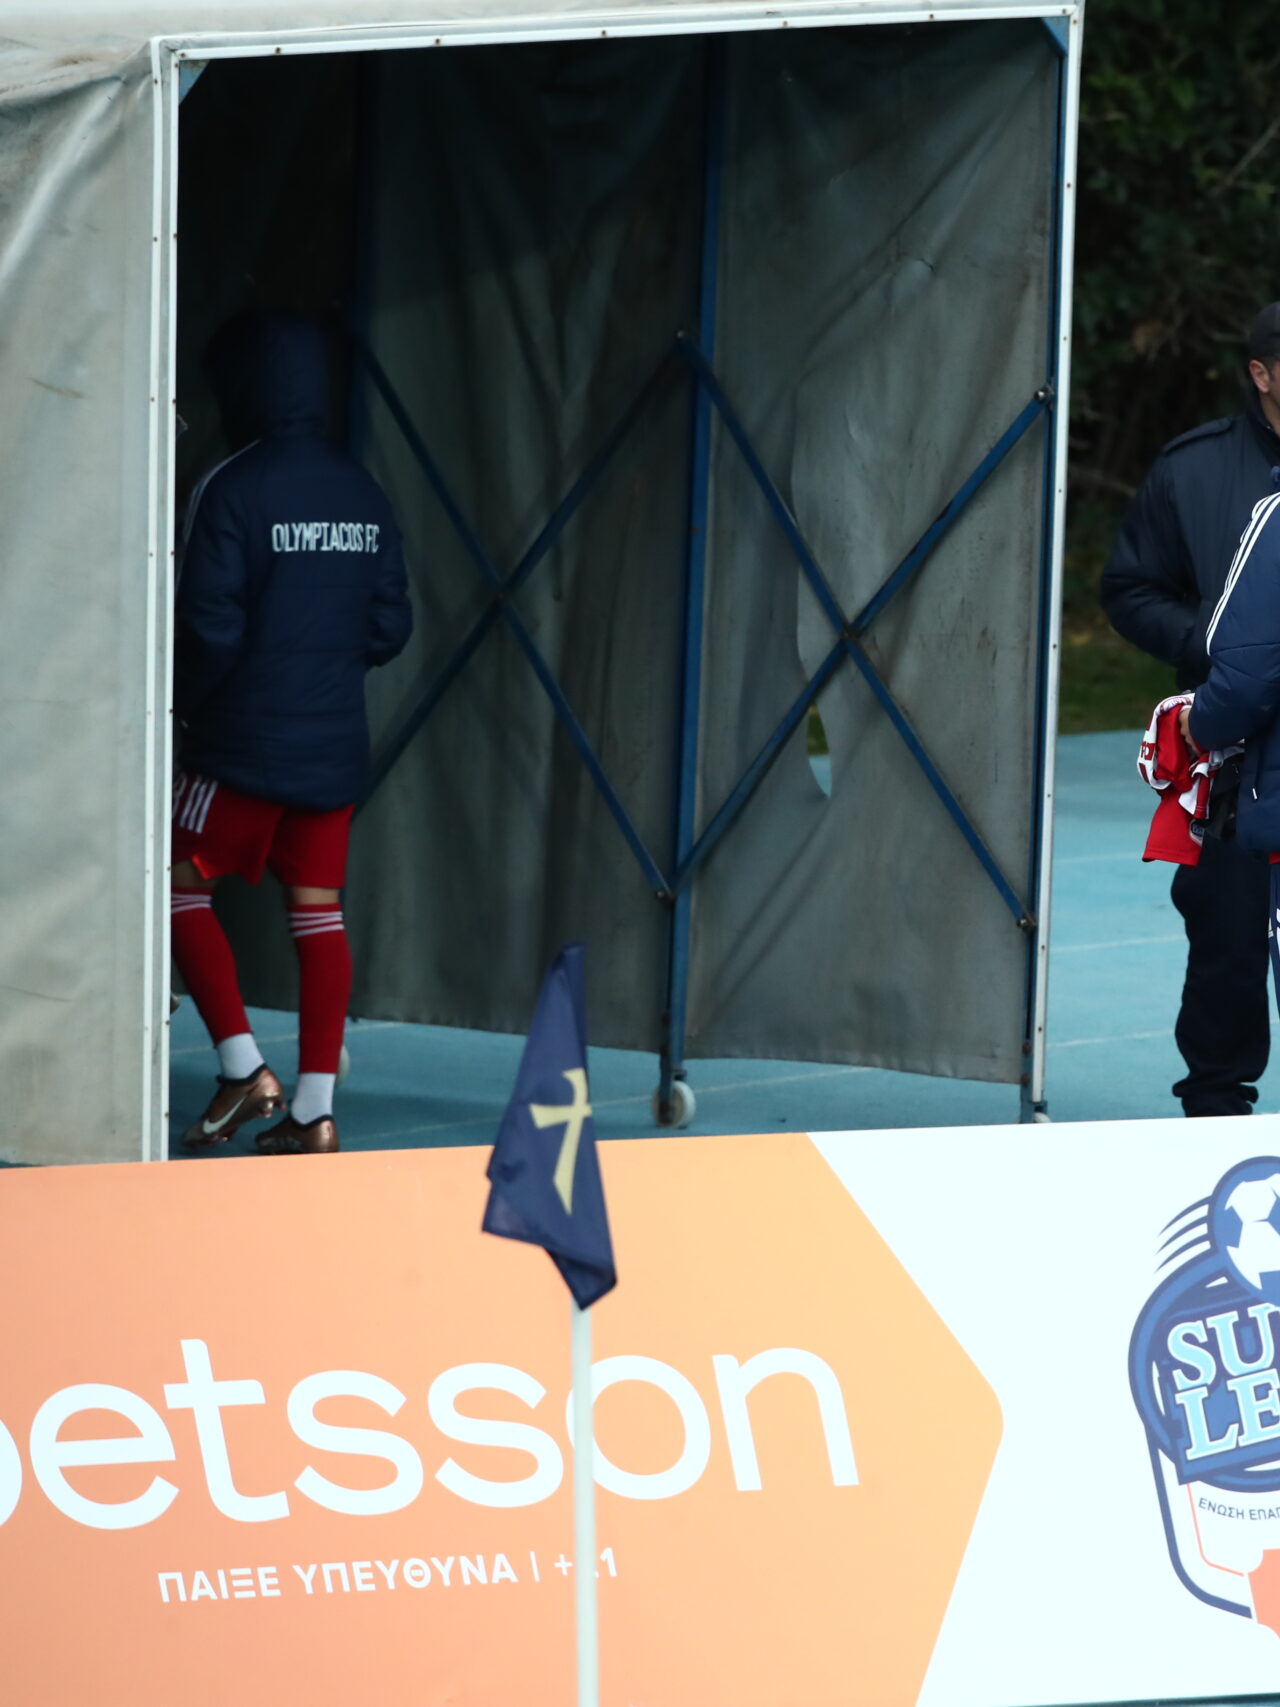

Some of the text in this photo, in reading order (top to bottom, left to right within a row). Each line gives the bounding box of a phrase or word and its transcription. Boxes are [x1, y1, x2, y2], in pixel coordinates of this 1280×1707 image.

[272, 522, 380, 553] OLYMPIACOS FC
[0, 1338, 860, 1530] etsson
[1198, 1497, 1246, 1520] ΕΝΩΣΗ
[157, 1566, 282, 1603] ΠΑΙΞΕ
[292, 1553, 519, 1595] ΥΠΕΥΘΥΝΑ
[554, 1547, 618, 1580] +1
